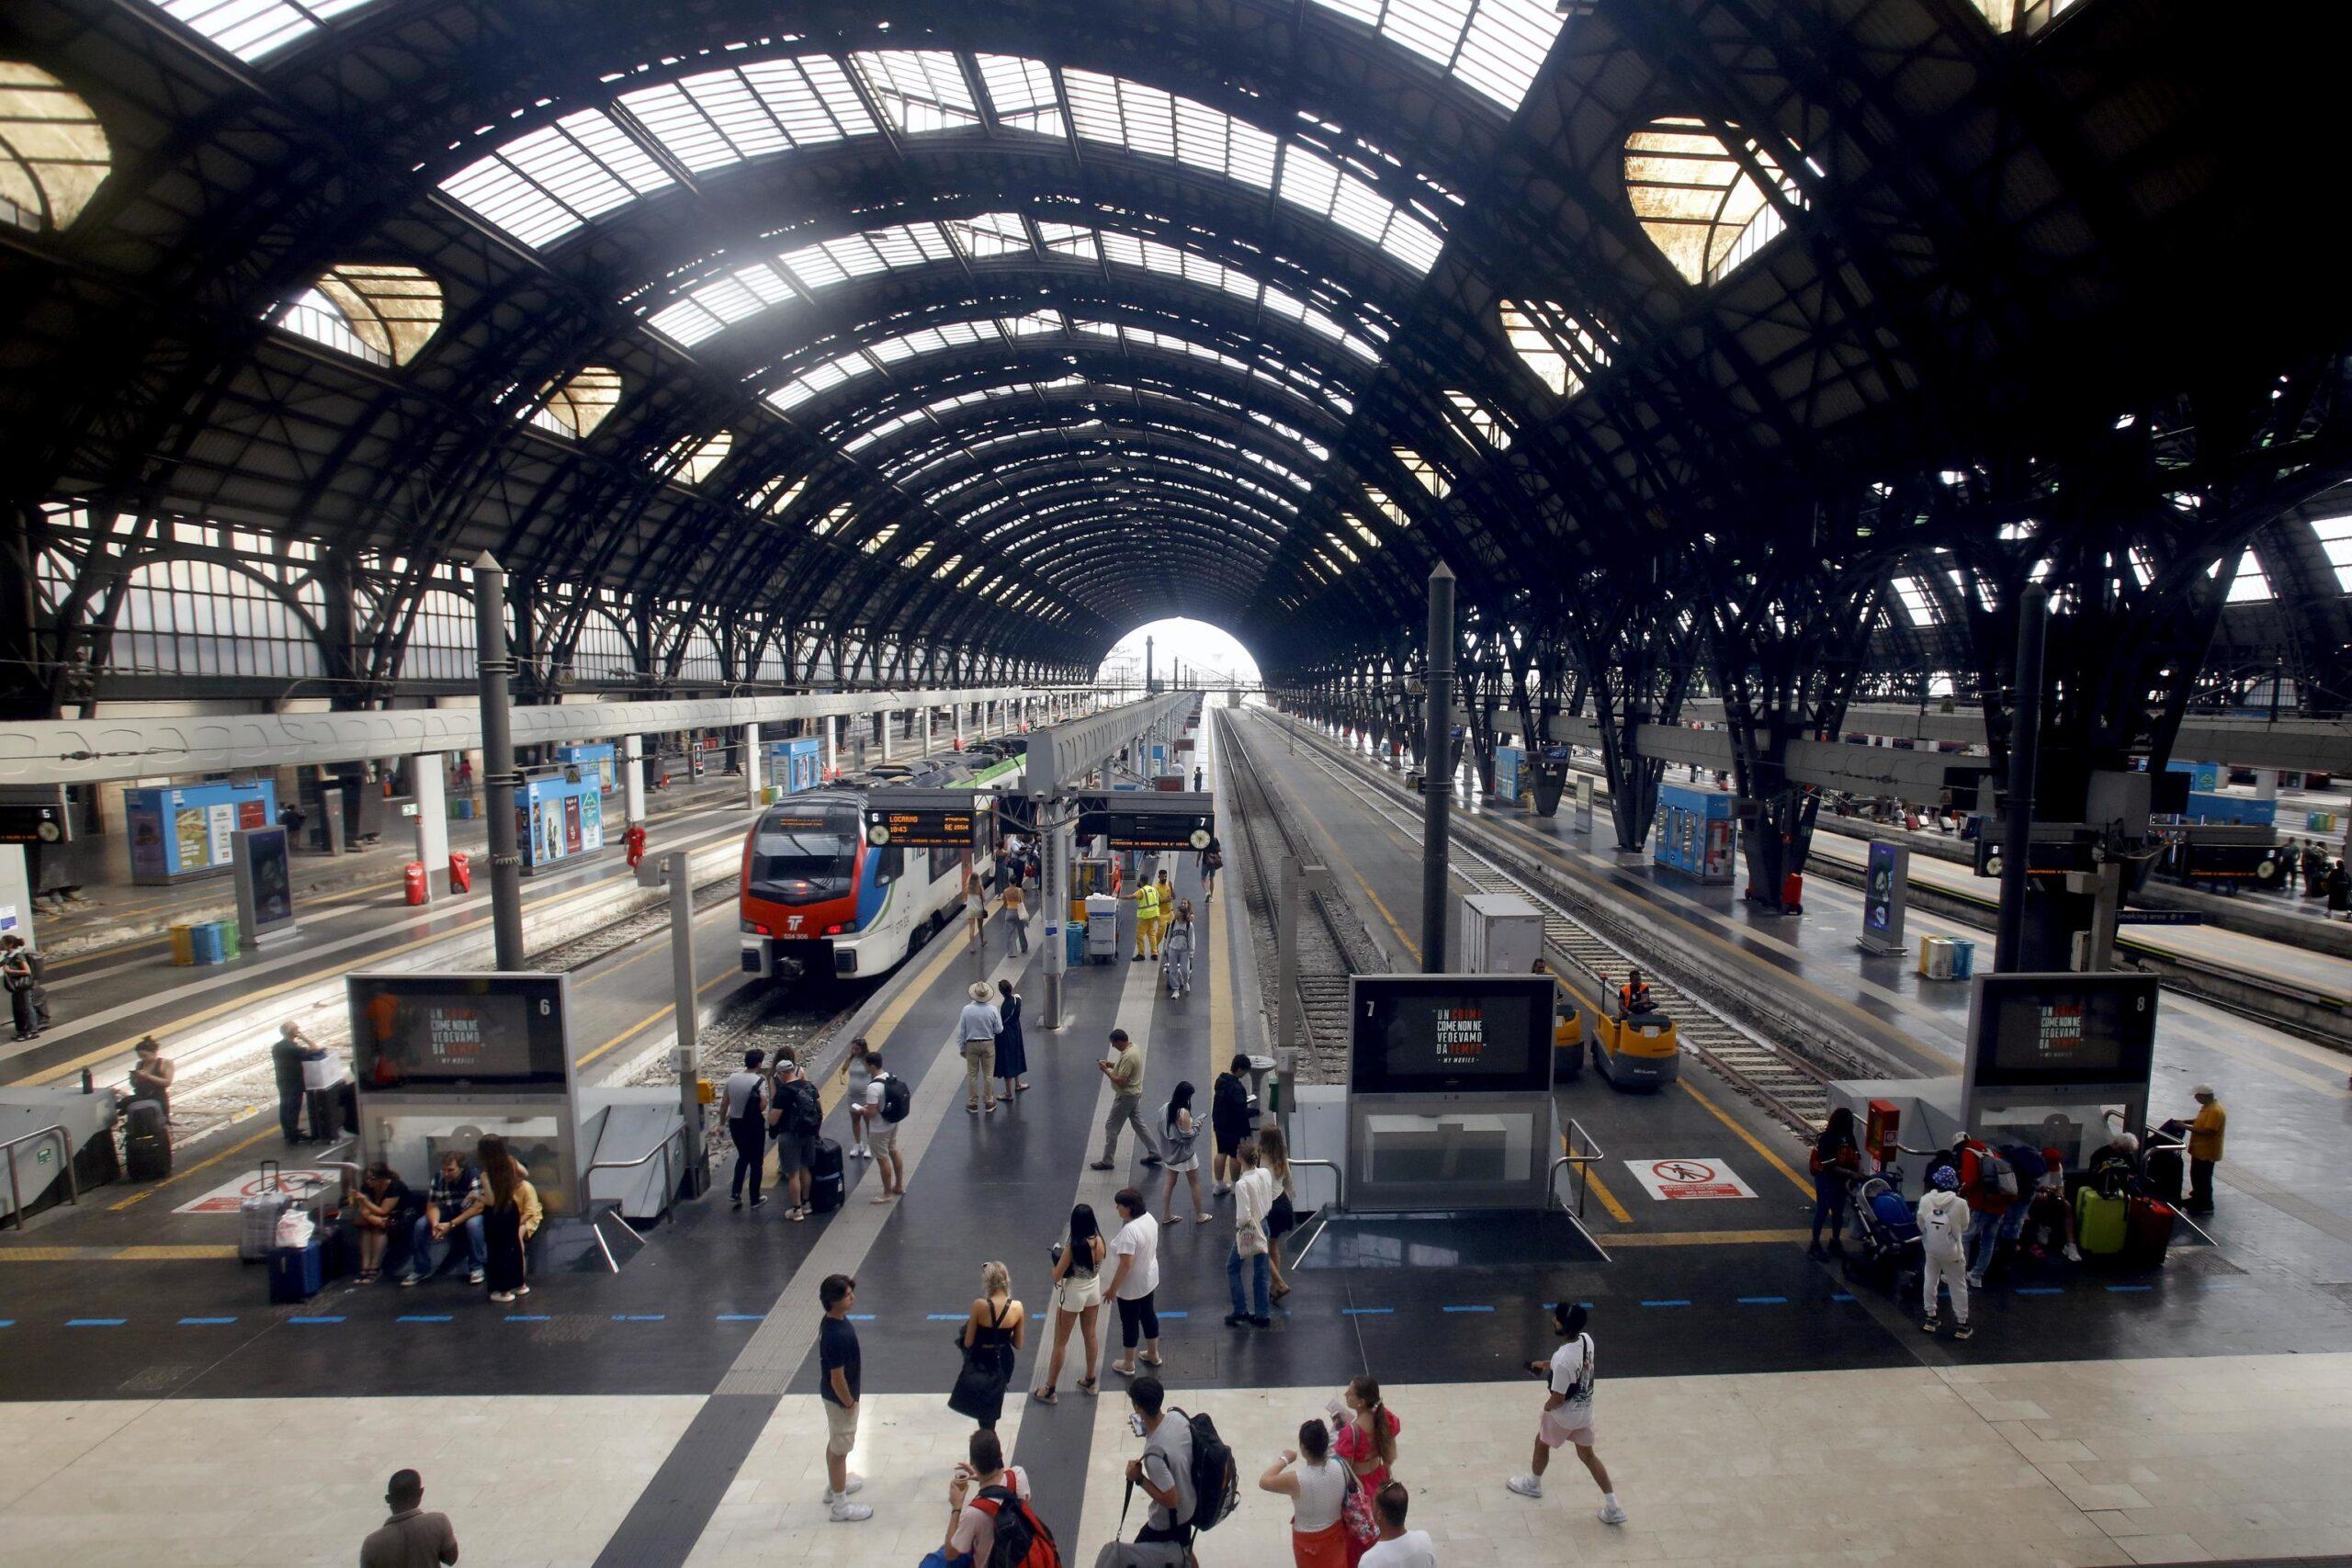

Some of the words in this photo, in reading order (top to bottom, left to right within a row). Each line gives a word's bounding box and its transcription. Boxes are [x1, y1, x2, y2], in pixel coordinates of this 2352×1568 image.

[872, 813, 879, 822] 6
[1200, 818, 1206, 827] 7
[1992, 845, 1999, 854] 8
[539, 998, 550, 1015] 6
[1366, 1000, 1374, 1017] 7
[2137, 996, 2145, 1011] 8
[431, 1020, 451, 1031] COME
[452, 1020, 468, 1031] NON
[1437, 1021, 1456, 1031] COME
[1457, 1021, 1472, 1031] NON
[1473, 1021, 1482, 1031] NE
[2041, 1016, 2058, 1027] COME
[2058, 1016, 2073, 1027] NON
[2073, 1016, 2081, 1027] NE
[432, 1032, 480, 1043] VEDEVAMO
[1437, 1032, 1482, 1043] VEDEVAMO
[2041, 1027, 2081, 1038] VEDEVAMO
[1436, 1043, 1448, 1055] DA
